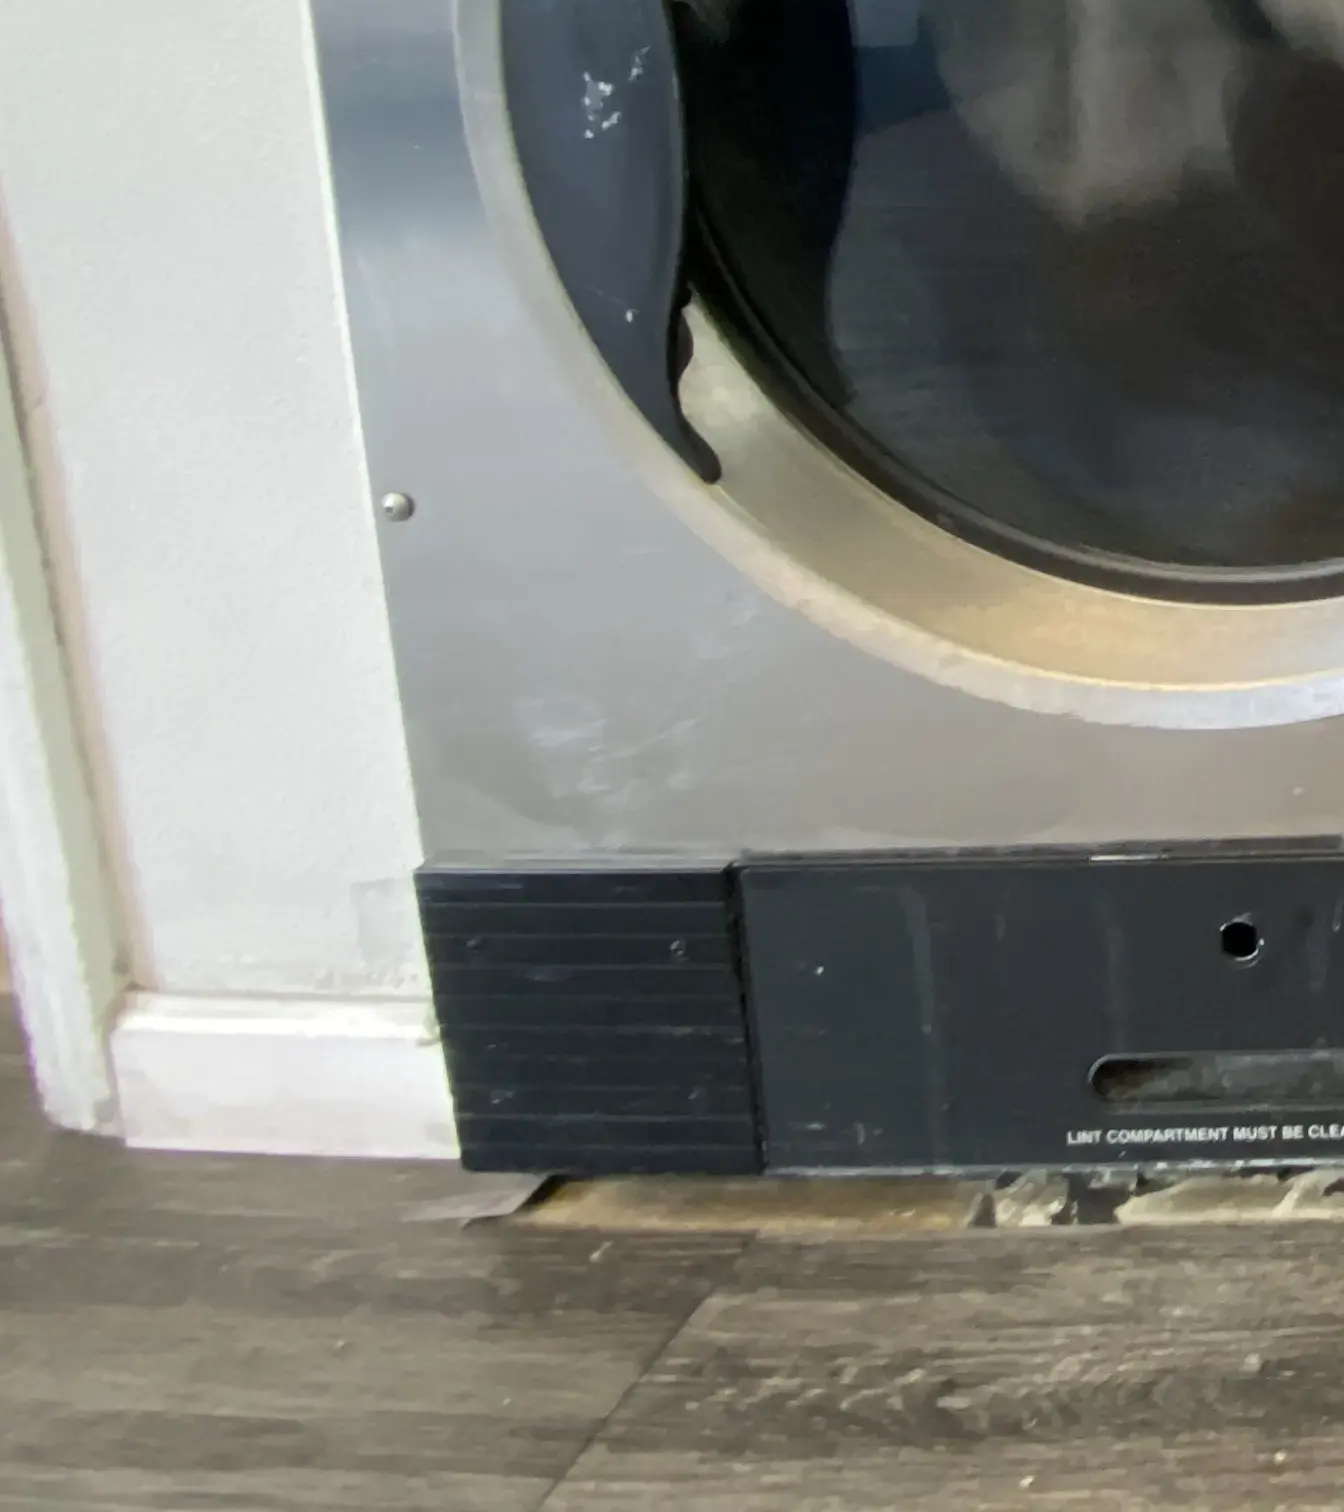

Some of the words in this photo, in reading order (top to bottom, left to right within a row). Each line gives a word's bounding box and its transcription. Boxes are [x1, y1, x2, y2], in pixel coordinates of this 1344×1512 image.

[1066, 1129, 1102, 1145] LINT
[1106, 1126, 1229, 1145] COMPARTMENT
[1232, 1125, 1278, 1142] MUST
[1282, 1124, 1304, 1140] BE
